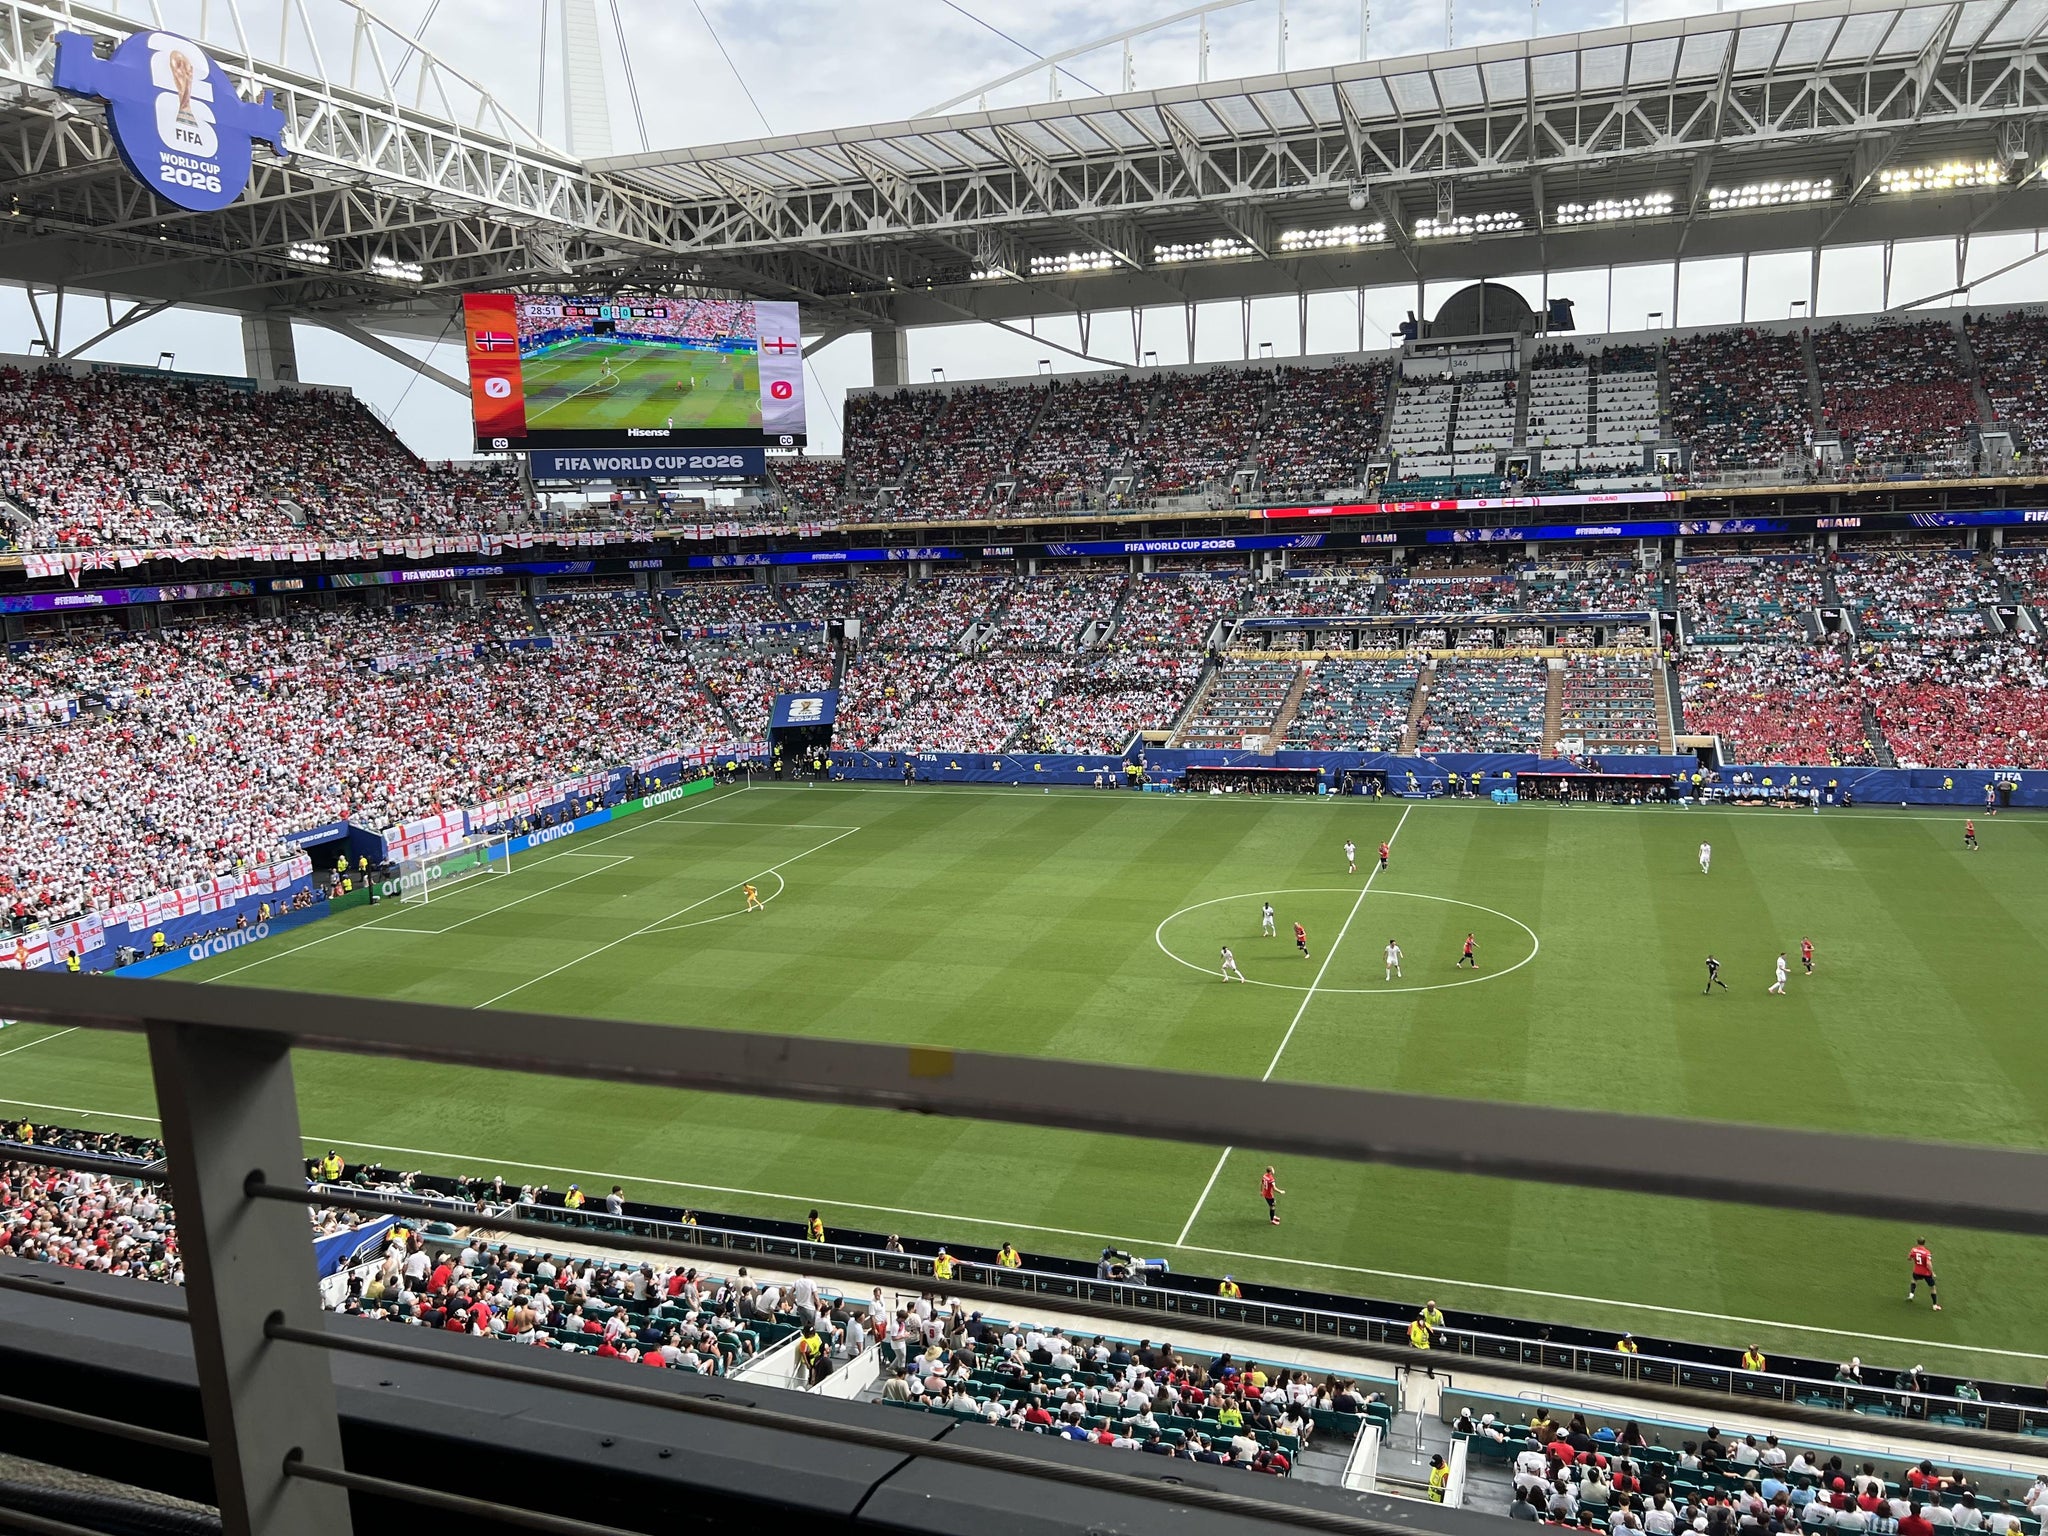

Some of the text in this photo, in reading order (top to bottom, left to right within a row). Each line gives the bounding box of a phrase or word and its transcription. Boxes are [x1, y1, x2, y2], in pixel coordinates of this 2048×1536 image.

[176, 128, 203, 146] FIFA
[160, 152, 221, 174] WORLD CUP
[160, 165, 222, 193] 2026
[531, 306, 556, 315] 28:51
[2026, 306, 2044, 314] 350
[1586, 338, 1601, 346] 347
[1332, 356, 1346, 364] 345
[1453, 360, 1469, 368] 346
[628, 428, 671, 437] Hisense
[494, 440, 507, 448] CC
[781, 437, 792, 445] CC
[555, 455, 744, 471] FIFA WORLD CUP 2026
[1816, 517, 1861, 528] MIAMI
[1575, 527, 1622, 536] #FIFAWorldCup
[1361, 533, 1397, 544] MIAMI
[1125, 540, 1236, 552] FIFA WORLD CUP 2026
[983, 547, 1014, 556] MIAMI
[629, 559, 662, 569] MIAMI
[402, 571, 419, 581] FIFA
[419, 570, 446, 580] WORLD
[466, 566, 504, 577] 2026
[271, 579, 304, 590] MIAMI
[920, 754, 938, 762] FIFA
[608, 772, 621, 782] FIFA
[1994, 771, 2023, 781] FIFA
[642, 787, 683, 809] aramco
[528, 821, 575, 847] aramco
[382, 863, 442, 896] aramco
[52, 931, 95, 949] BLACKPOOL
[189, 922, 269, 961] aramco
[1915, 1252, 1923, 1265] 5
[929, 1328, 935, 1338] 9
[1816, 1514, 1826, 1524] 7
